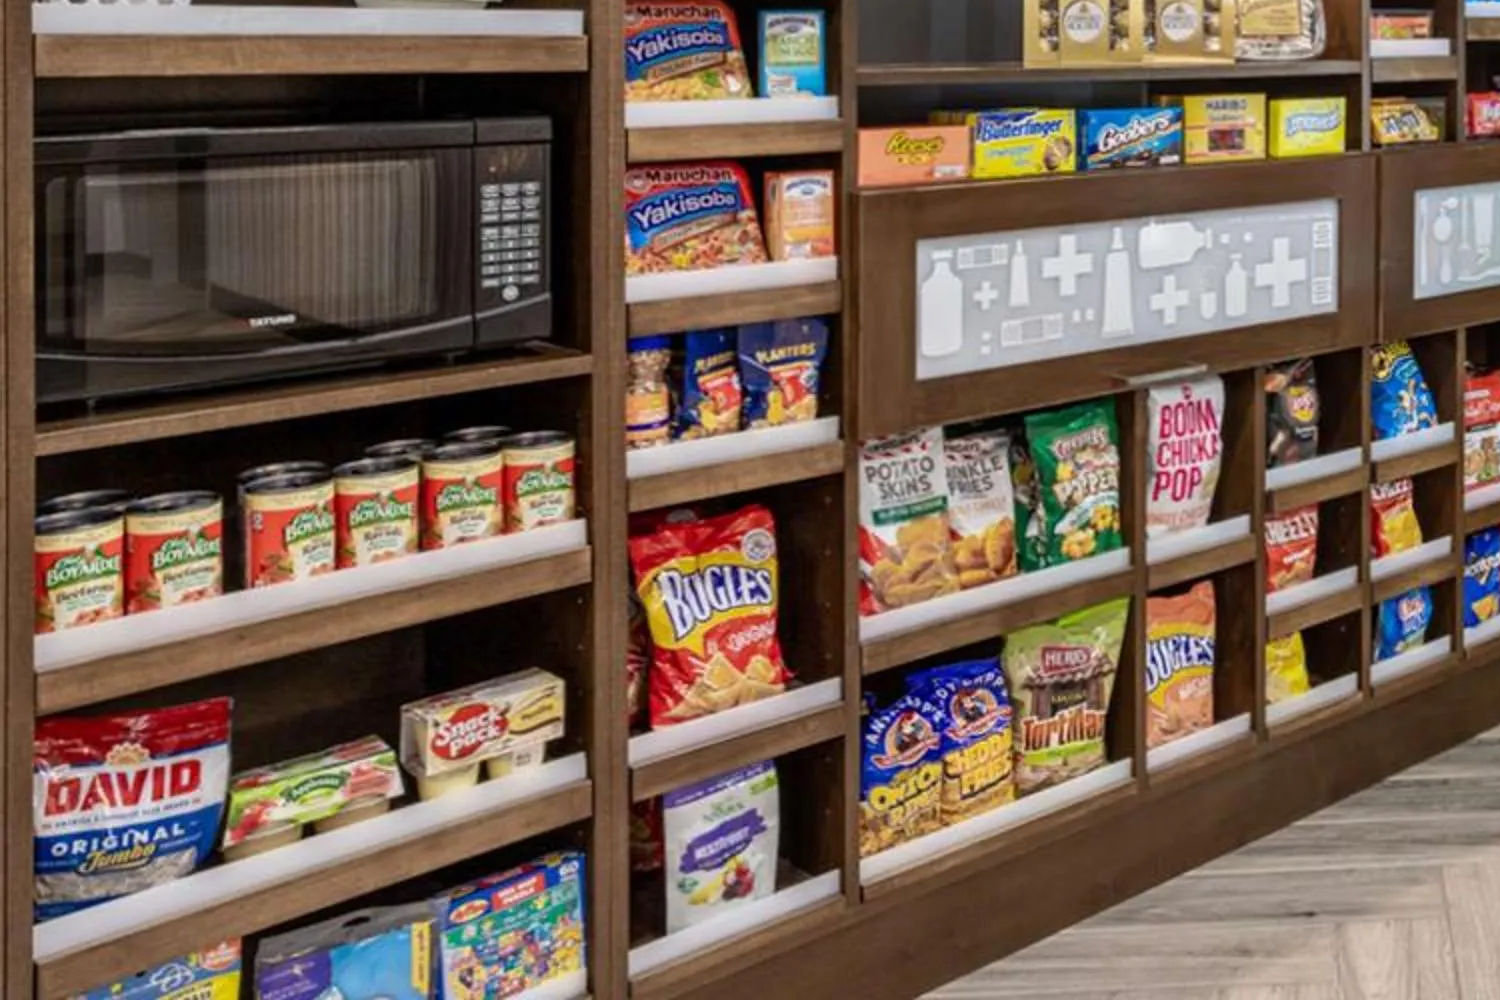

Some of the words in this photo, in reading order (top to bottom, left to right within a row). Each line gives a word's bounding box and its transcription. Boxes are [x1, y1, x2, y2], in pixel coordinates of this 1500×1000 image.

[637, 5, 721, 18] Maruchan
[627, 26, 724, 62] Yakisoba
[981, 118, 1062, 142] Butterfinger
[1099, 111, 1173, 151] Goobers
[648, 167, 733, 183] Maruchan
[636, 191, 736, 229] Yakisoba
[755, 342, 817, 365] PLANTERS
[1159, 397, 1219, 440] BOOM
[865, 455, 935, 483] POTATO
[945, 454, 1003, 478] INKLE
[1152, 465, 1203, 502] POP
[879, 474, 932, 500] SKINS
[657, 564, 773, 642] BUGLES
[433, 706, 503, 747] Snack
[43, 759, 203, 817] DAVID
[51, 822, 186, 857] ORIGINAL
[82, 842, 157, 873] Jumbo
